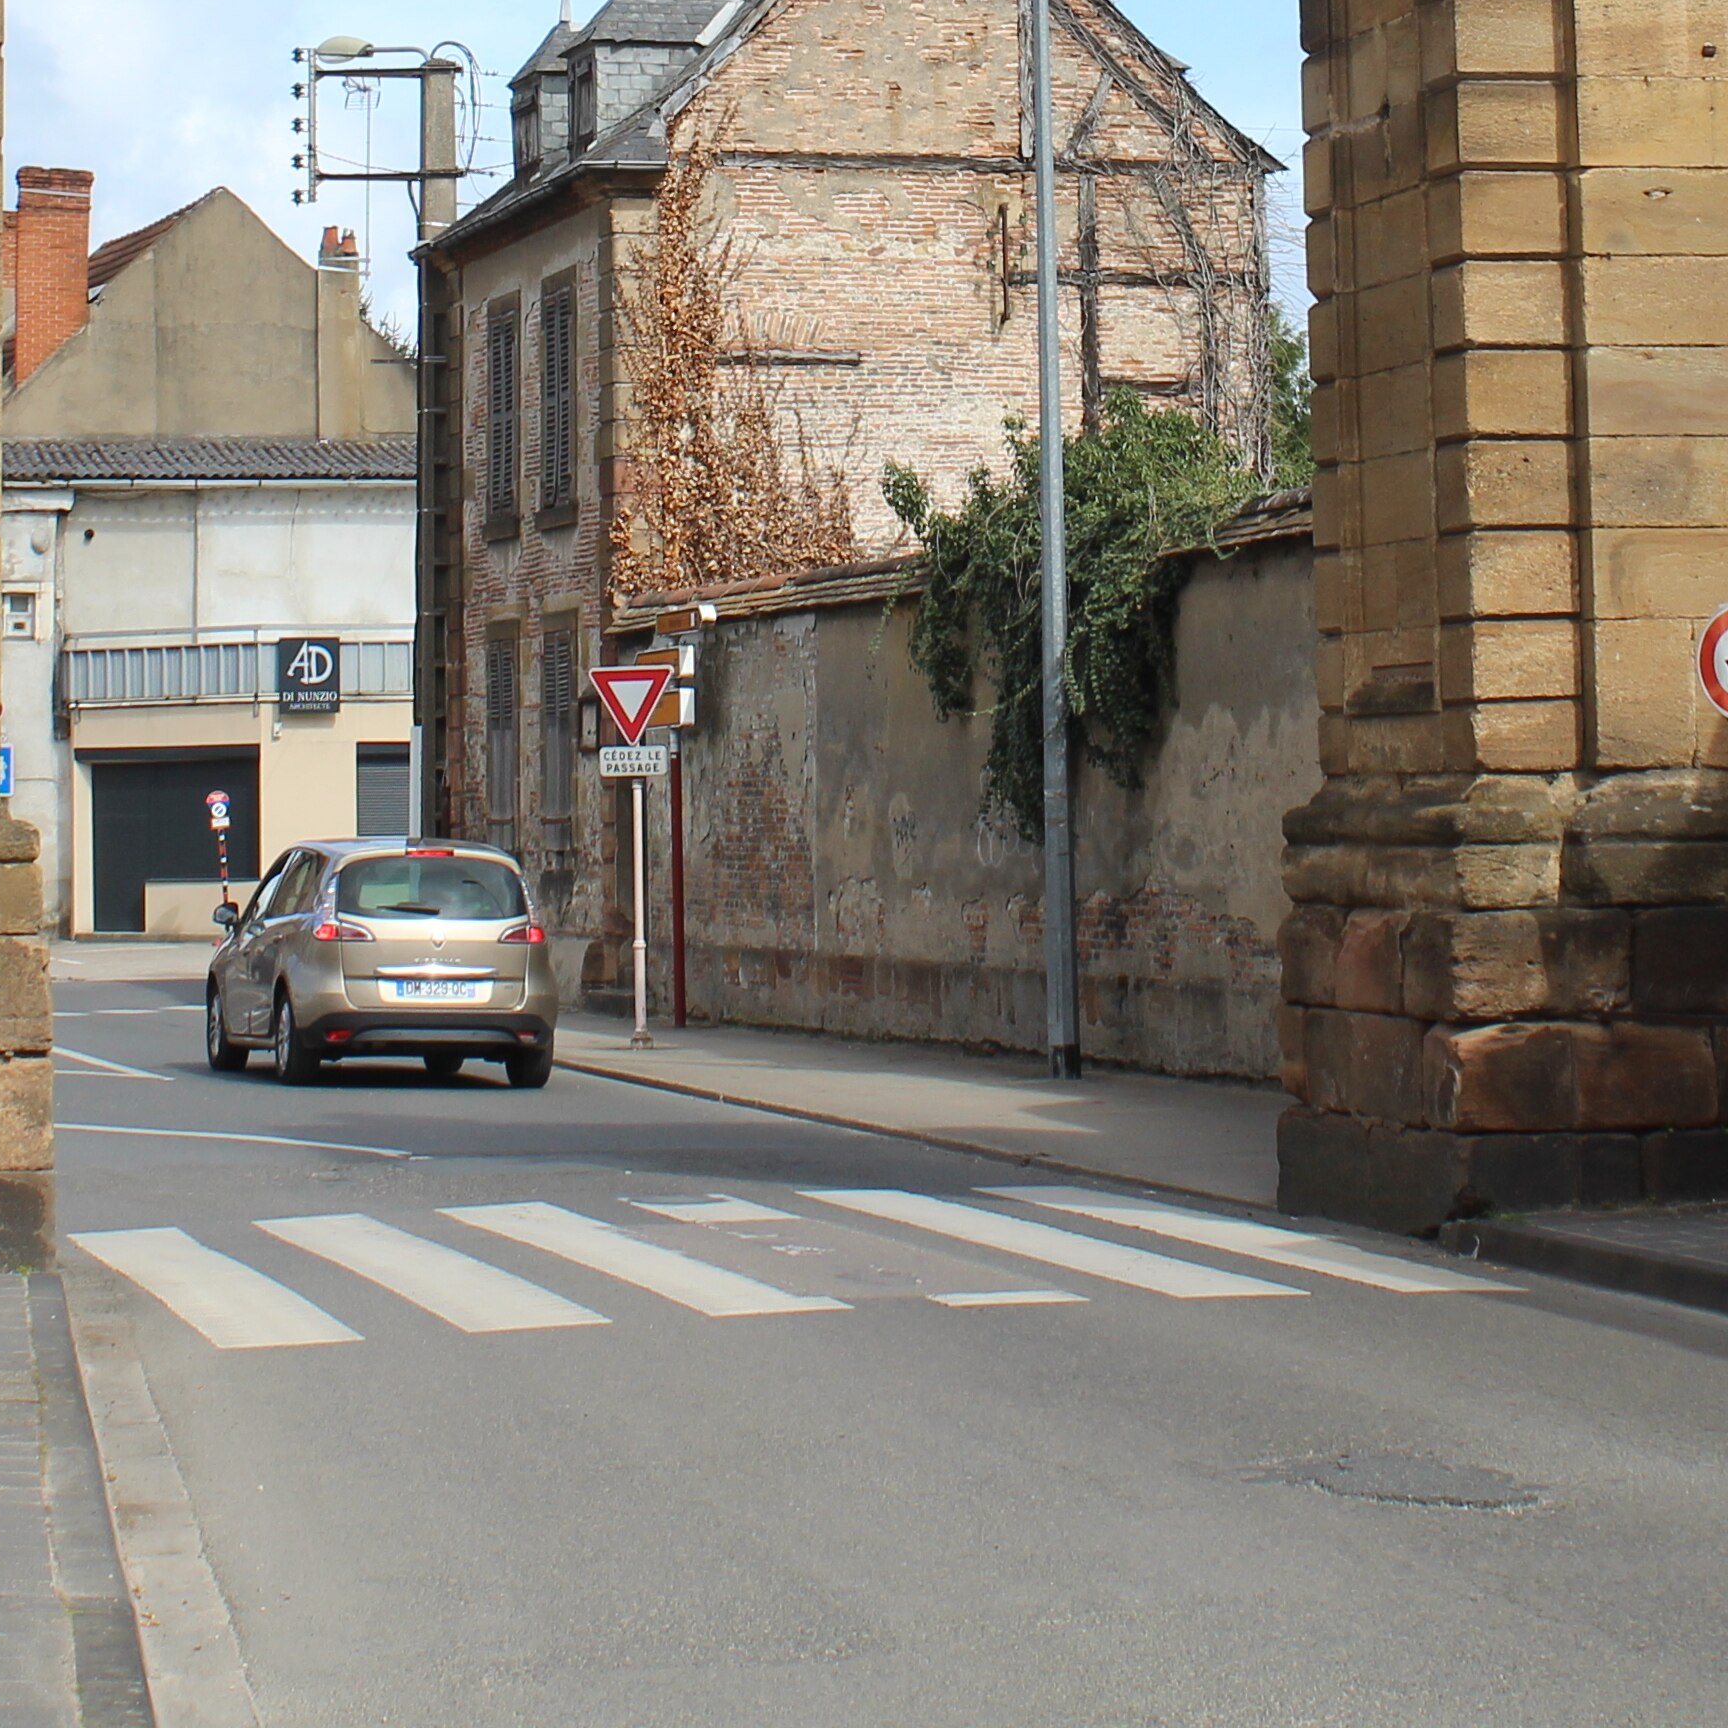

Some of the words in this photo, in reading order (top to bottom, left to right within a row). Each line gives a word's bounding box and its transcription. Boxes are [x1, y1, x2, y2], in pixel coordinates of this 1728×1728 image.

[282, 691, 294, 702] DI
[297, 691, 338, 702] NUNZIO
[603, 749, 642, 761] CÉDEZ
[648, 751, 661, 761] LE
[606, 763, 660, 773] PASSAGE
